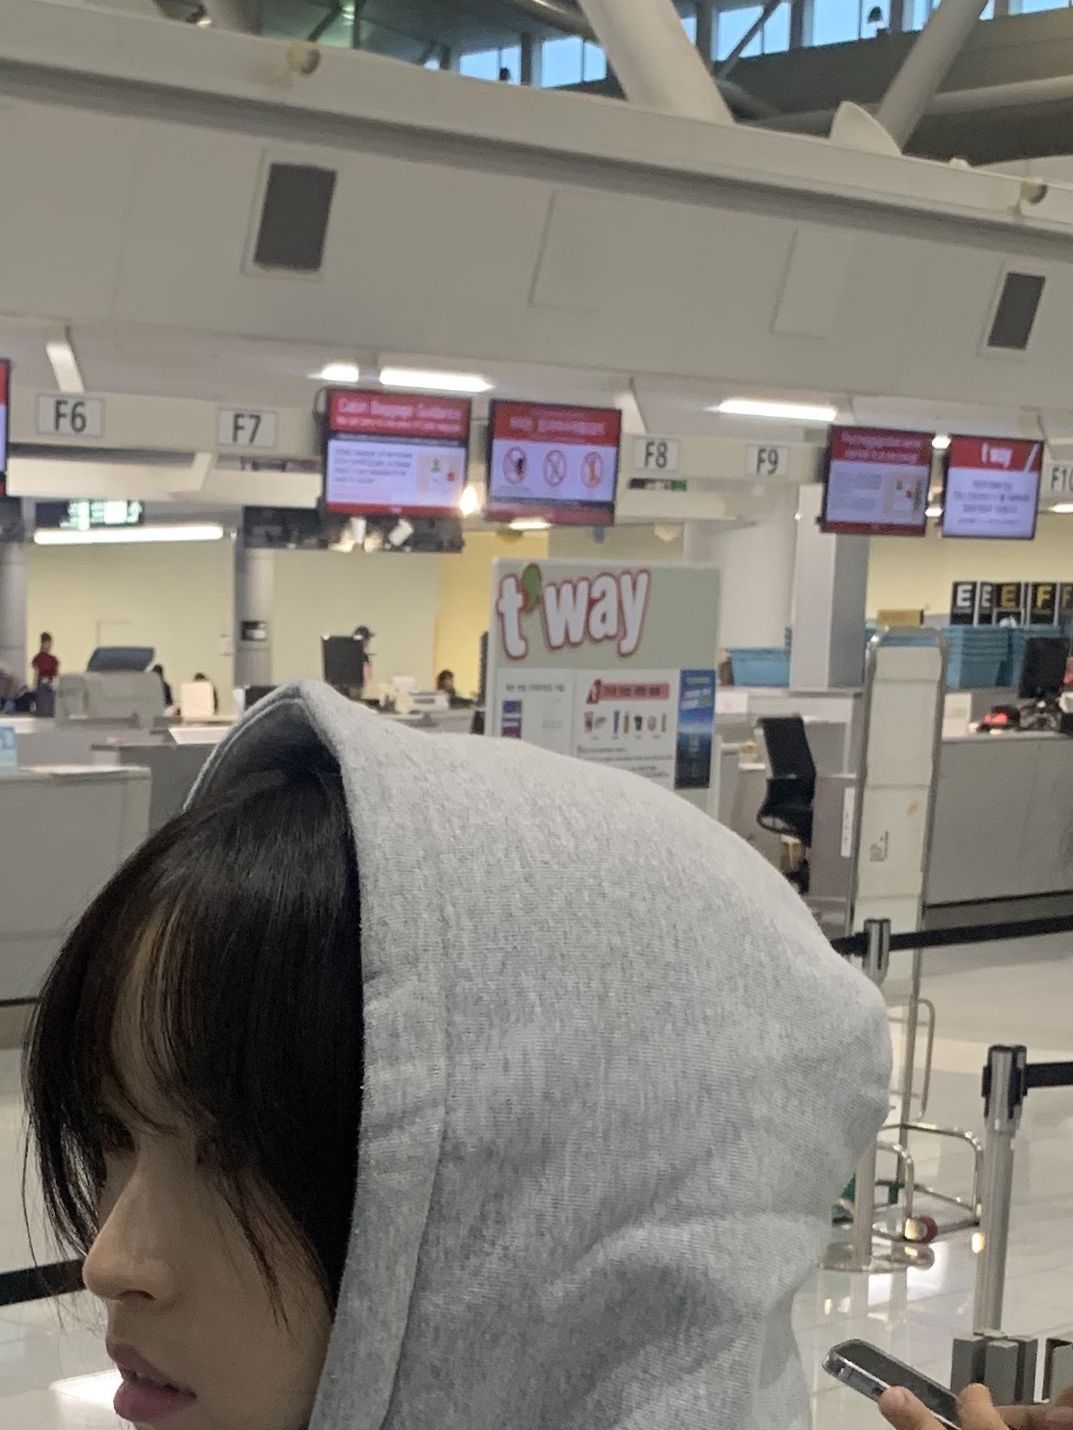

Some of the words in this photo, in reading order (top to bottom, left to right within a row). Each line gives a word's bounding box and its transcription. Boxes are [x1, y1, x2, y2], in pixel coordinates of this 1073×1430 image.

[54, 400, 87, 433] F6
[233, 413, 262, 444] F7
[644, 442, 669, 469] F8
[756, 447, 779, 475] F9
[956, 584, 973, 608] E
[1000, 585, 1017, 608] E
[1036, 585, 1052, 608] F
